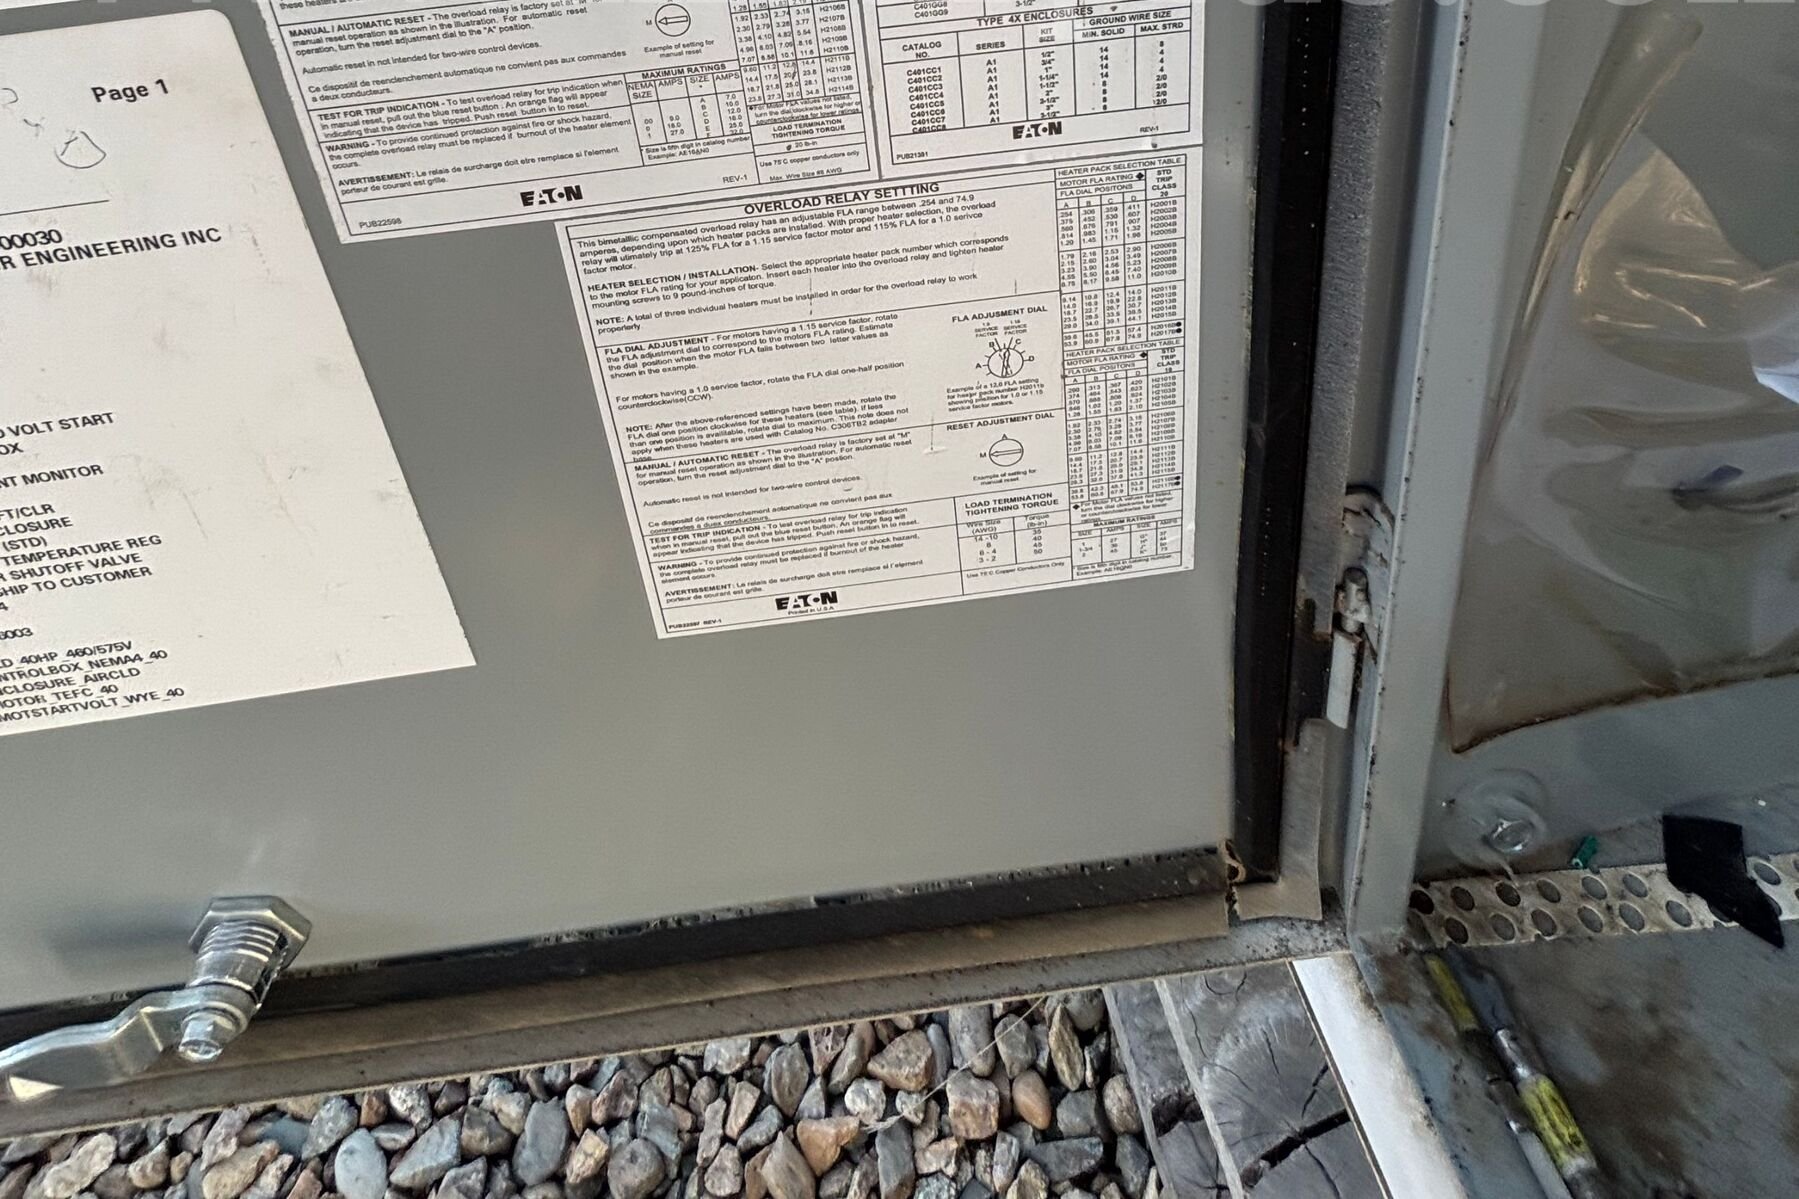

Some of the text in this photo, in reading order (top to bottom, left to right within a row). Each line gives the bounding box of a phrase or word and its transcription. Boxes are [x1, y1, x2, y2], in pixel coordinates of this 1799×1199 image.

[976, 6, 1094, 27] TYPE 4X ENCLOSURES
[90, 78, 168, 102] Page 1
[743, 196, 821, 214] OVERLOAD
[824, 189, 870, 204] RELAY
[19, 227, 221, 266] ENGINEERING INC
[7, 412, 113, 436] VOLT START
[946, 421, 973, 430] RESET
[976, 414, 1032, 427] ADJUSTMENT
[20, 464, 103, 485] MONITOR
[964, 492, 1052, 509] LOAD TERMINATION
[0, 534, 161, 566] TEMPERATURE REG
[8, 552, 142, 580] SHUTOFF VALVE
[31, 566, 152, 591] TO CUSTOMER
